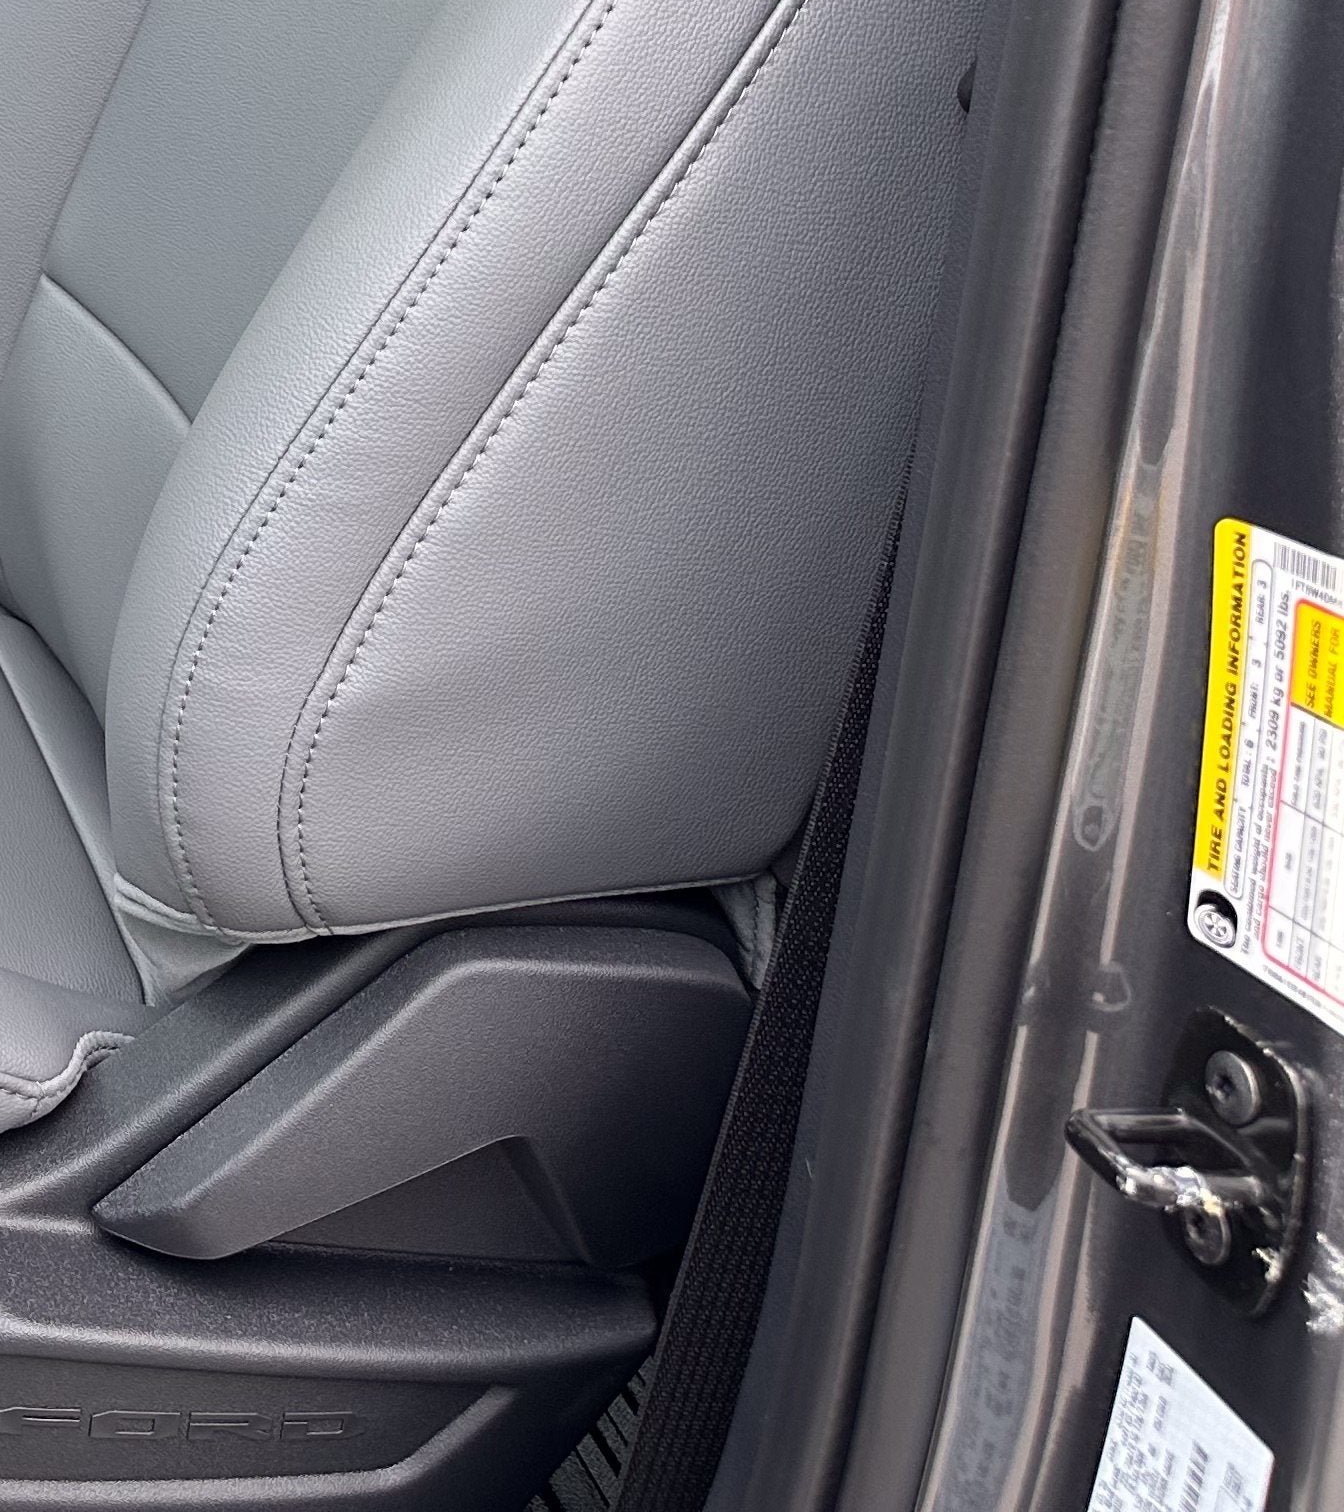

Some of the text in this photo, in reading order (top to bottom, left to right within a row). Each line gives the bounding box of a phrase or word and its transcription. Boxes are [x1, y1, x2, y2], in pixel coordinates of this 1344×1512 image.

[1255, 580, 1267, 624] REAR: 3
[1277, 590, 1290, 616] lbs.
[1274, 619, 1287, 660] 5092
[1327, 628, 1339, 655] FOR
[1252, 659, 1261, 668] 3
[1274, 666, 1283, 682] or
[1305, 619, 1321, 708] SEE OWNERS
[1207, 530, 1247, 872] TIRE AND LOADING INFORMATION
[1271, 689, 1284, 707] kg
[1323, 662, 1338, 718] MANUAL
[1266, 711, 1280, 751] 2309
[1229, 807, 1246, 894] SEATING CAPACITY
